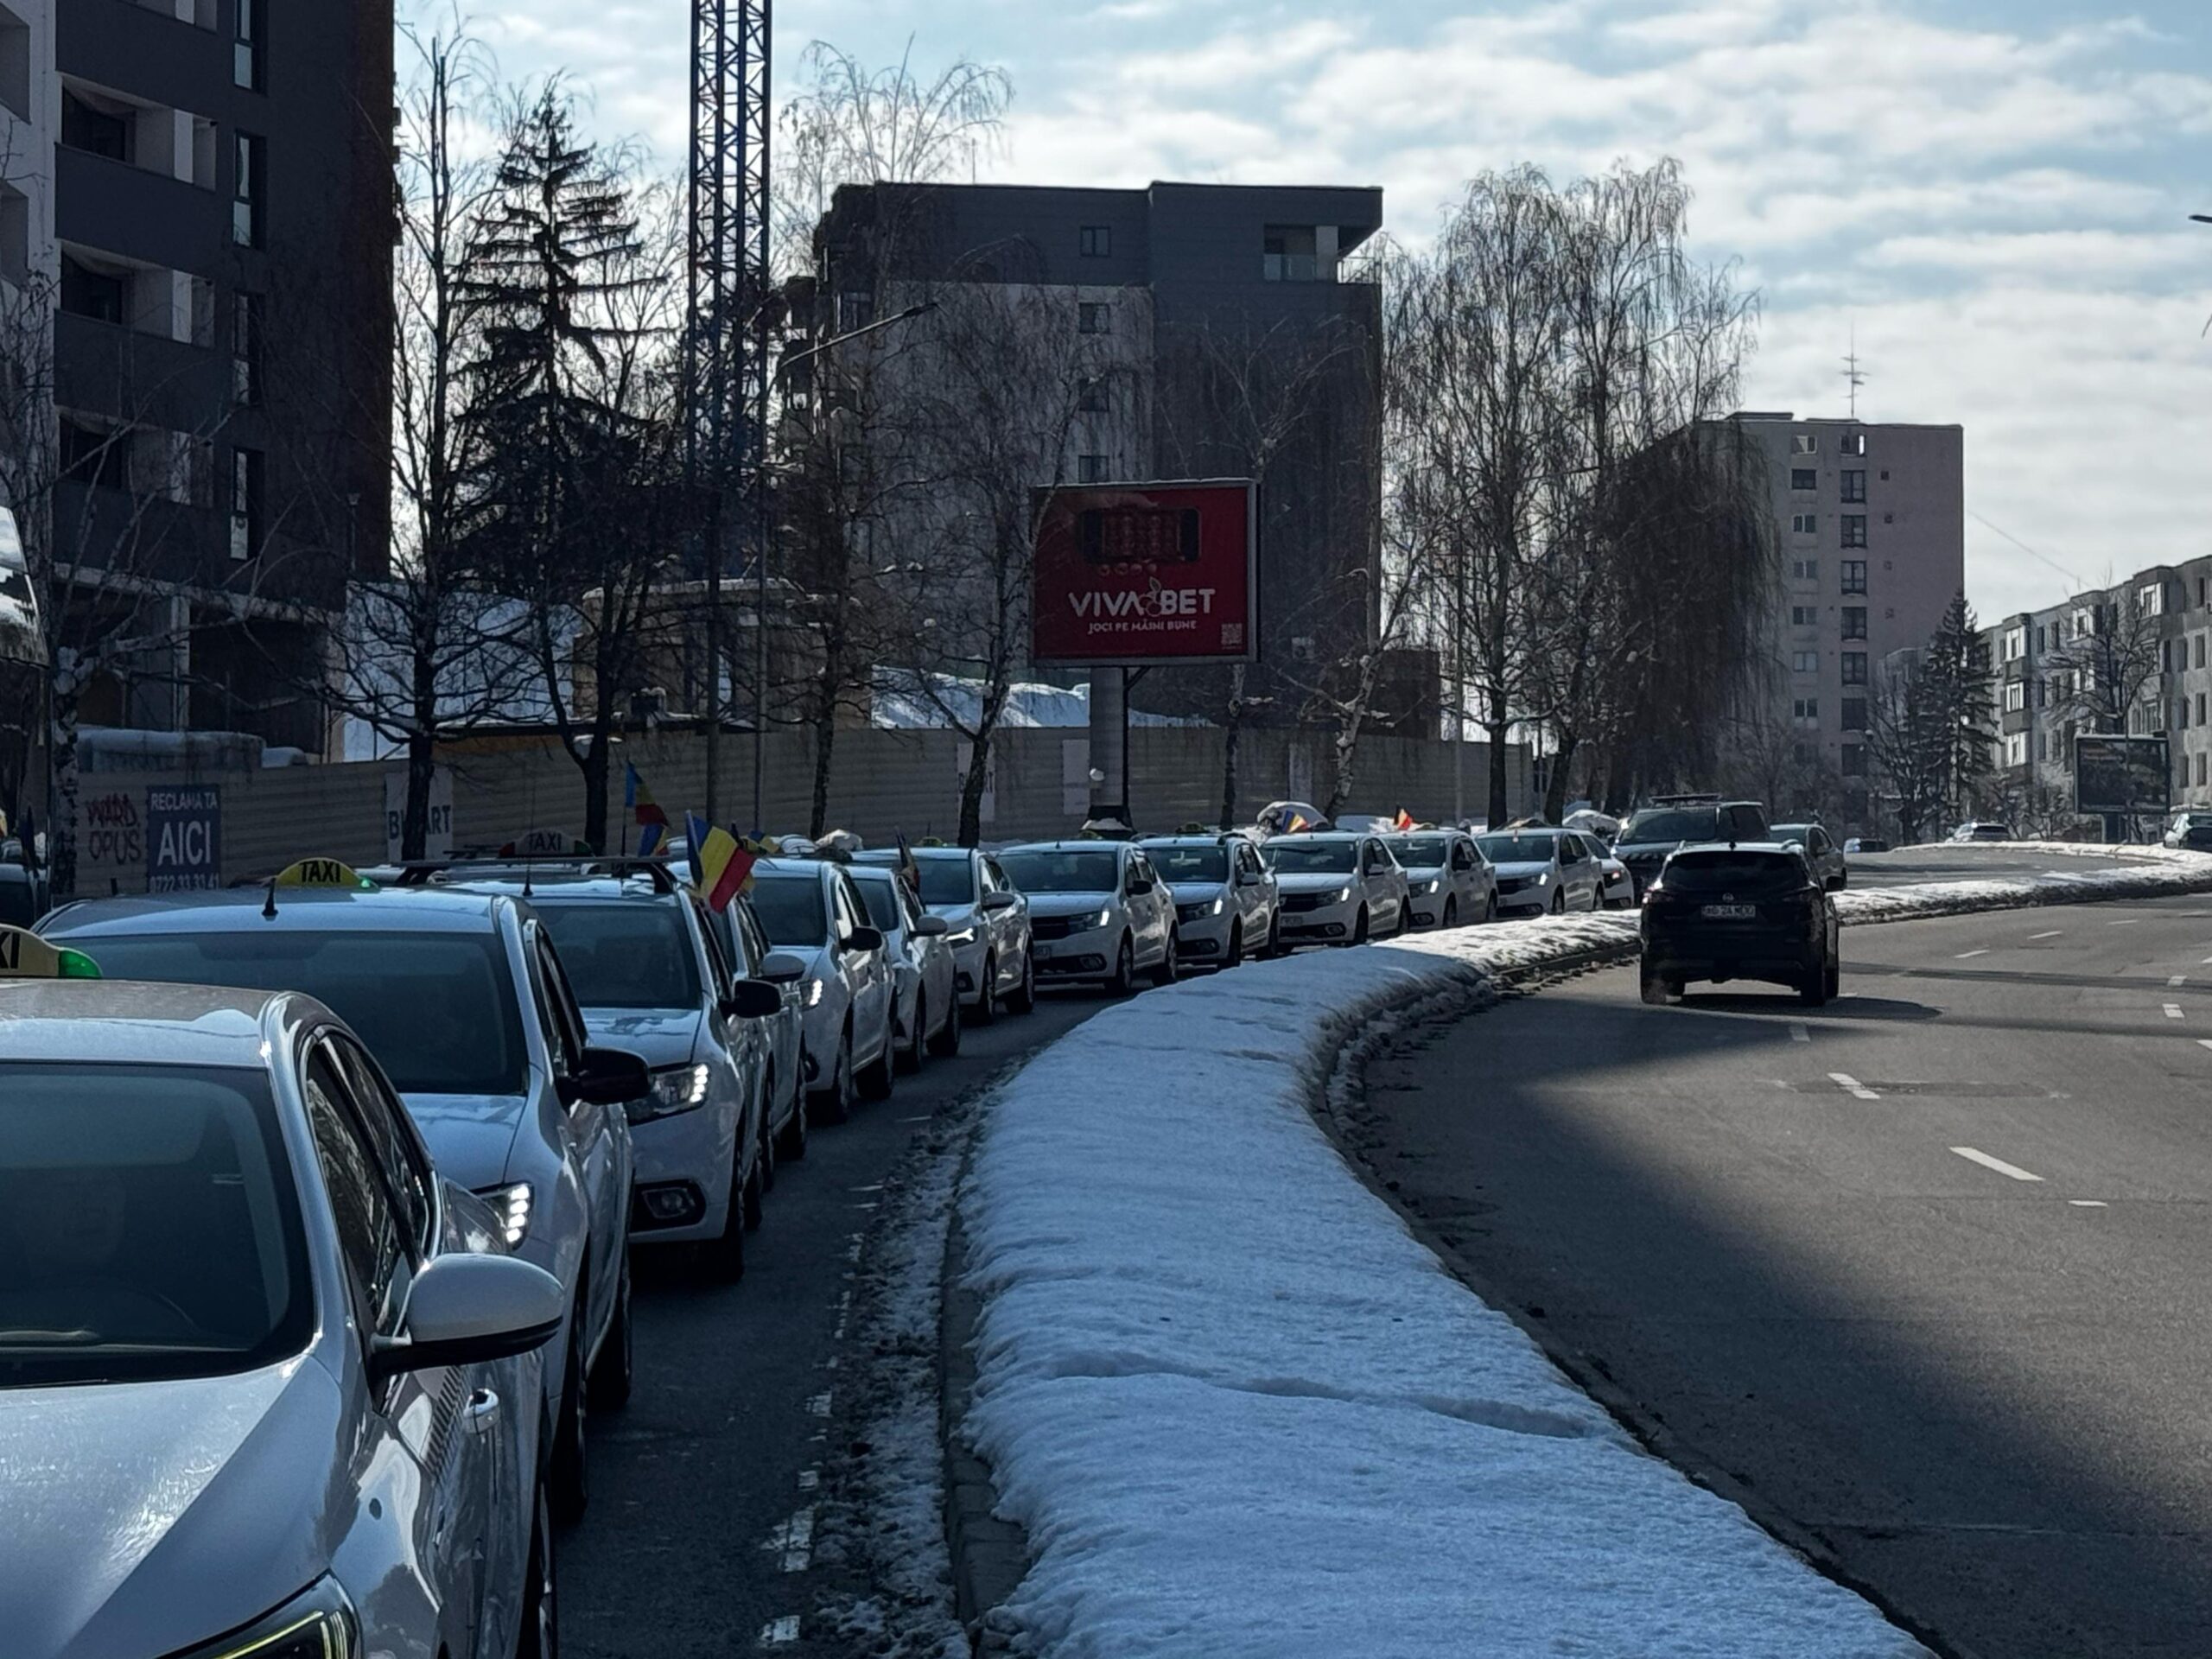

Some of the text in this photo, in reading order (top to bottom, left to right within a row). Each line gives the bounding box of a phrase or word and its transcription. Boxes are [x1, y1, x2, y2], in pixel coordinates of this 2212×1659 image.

[1087, 621, 1113, 635] JOCI
[1115, 621, 1128, 632] PE
[1167, 620, 1197, 631] BUNE
[204, 791, 219, 809] TA
[156, 820, 211, 867] AICI
[528, 833, 562, 852] TAXI
[299, 861, 340, 883] TAXI
